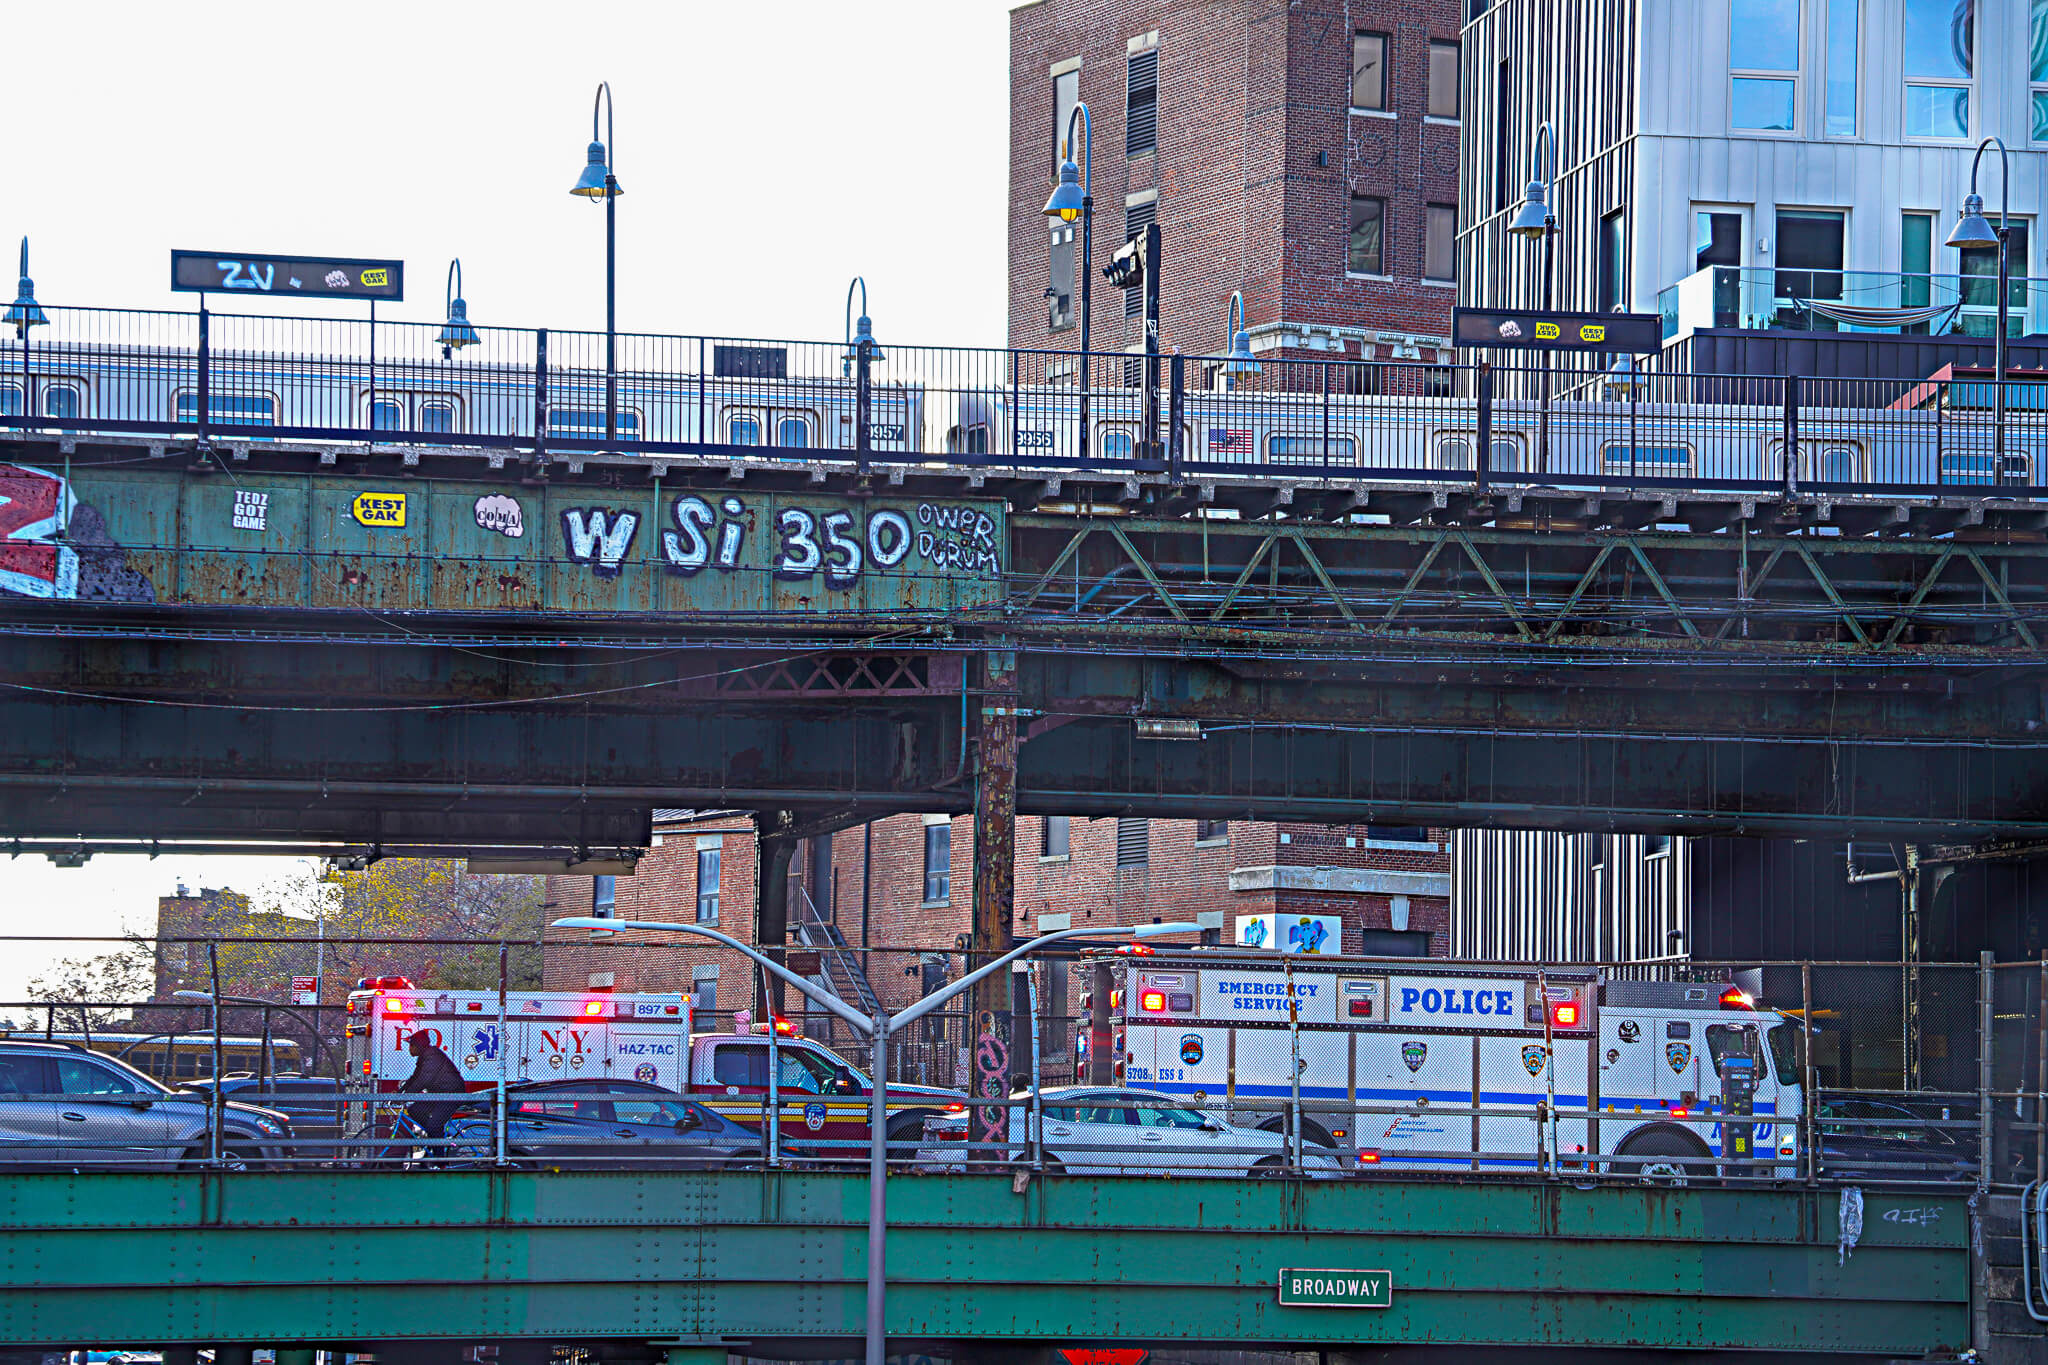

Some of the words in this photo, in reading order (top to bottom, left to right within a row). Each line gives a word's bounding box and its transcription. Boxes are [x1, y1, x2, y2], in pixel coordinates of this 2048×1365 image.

[364, 270, 386, 279] KEST
[235, 490, 268, 506] TEDZ
[359, 498, 404, 511] KEST
[234, 503, 267, 518] GOT
[363, 509, 398, 522] GAK
[478, 510, 516, 525] COMA
[233, 515, 266, 530] GAME
[1218, 981, 1319, 997] EMERGECY
[1401, 987, 1513, 1016] POLICE
[638, 1004, 661, 1015] 897
[539, 1030, 592, 1053] N.Y.
[618, 1044, 675, 1056] HAZ-TAC
[1159, 1068, 1175, 1081] ESS
[1177, 1069, 1184, 1081] 8
[1292, 1279, 1380, 1297] BROADWAY
